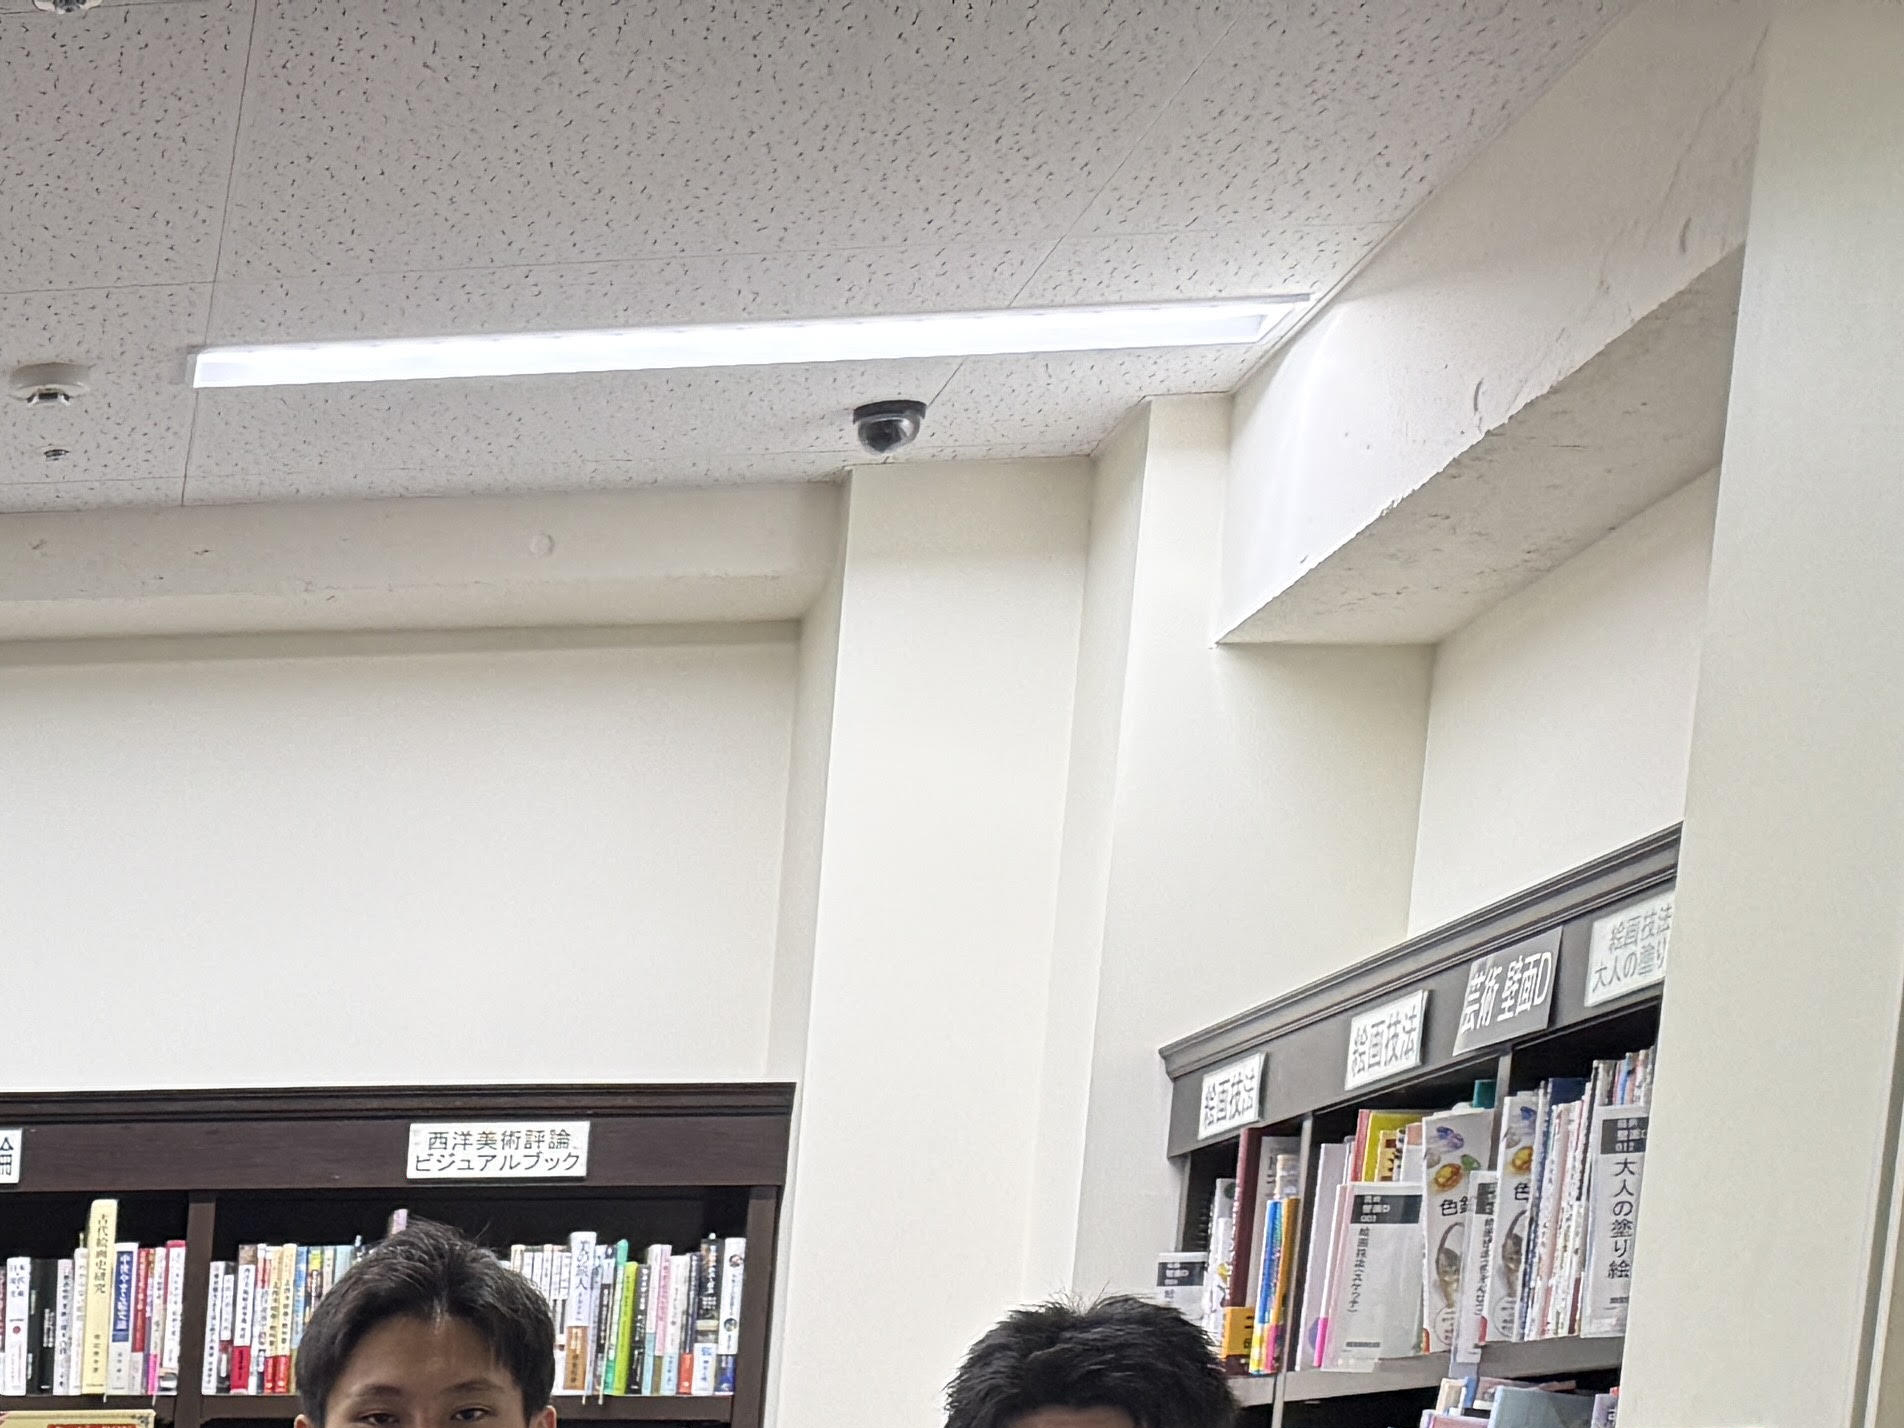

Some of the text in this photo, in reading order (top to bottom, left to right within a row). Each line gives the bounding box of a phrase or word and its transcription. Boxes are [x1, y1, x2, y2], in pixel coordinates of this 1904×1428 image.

[1499, 951, 1552, 1021] 壁面D
[1350, 1006, 1418, 1075] 絵画技法
[416, 1152, 579, 1171] ビジュアルブック
[428, 1129, 571, 1150] 西洋美術評論
[1608, 1158, 1637, 1279] 大人の塗り絵
